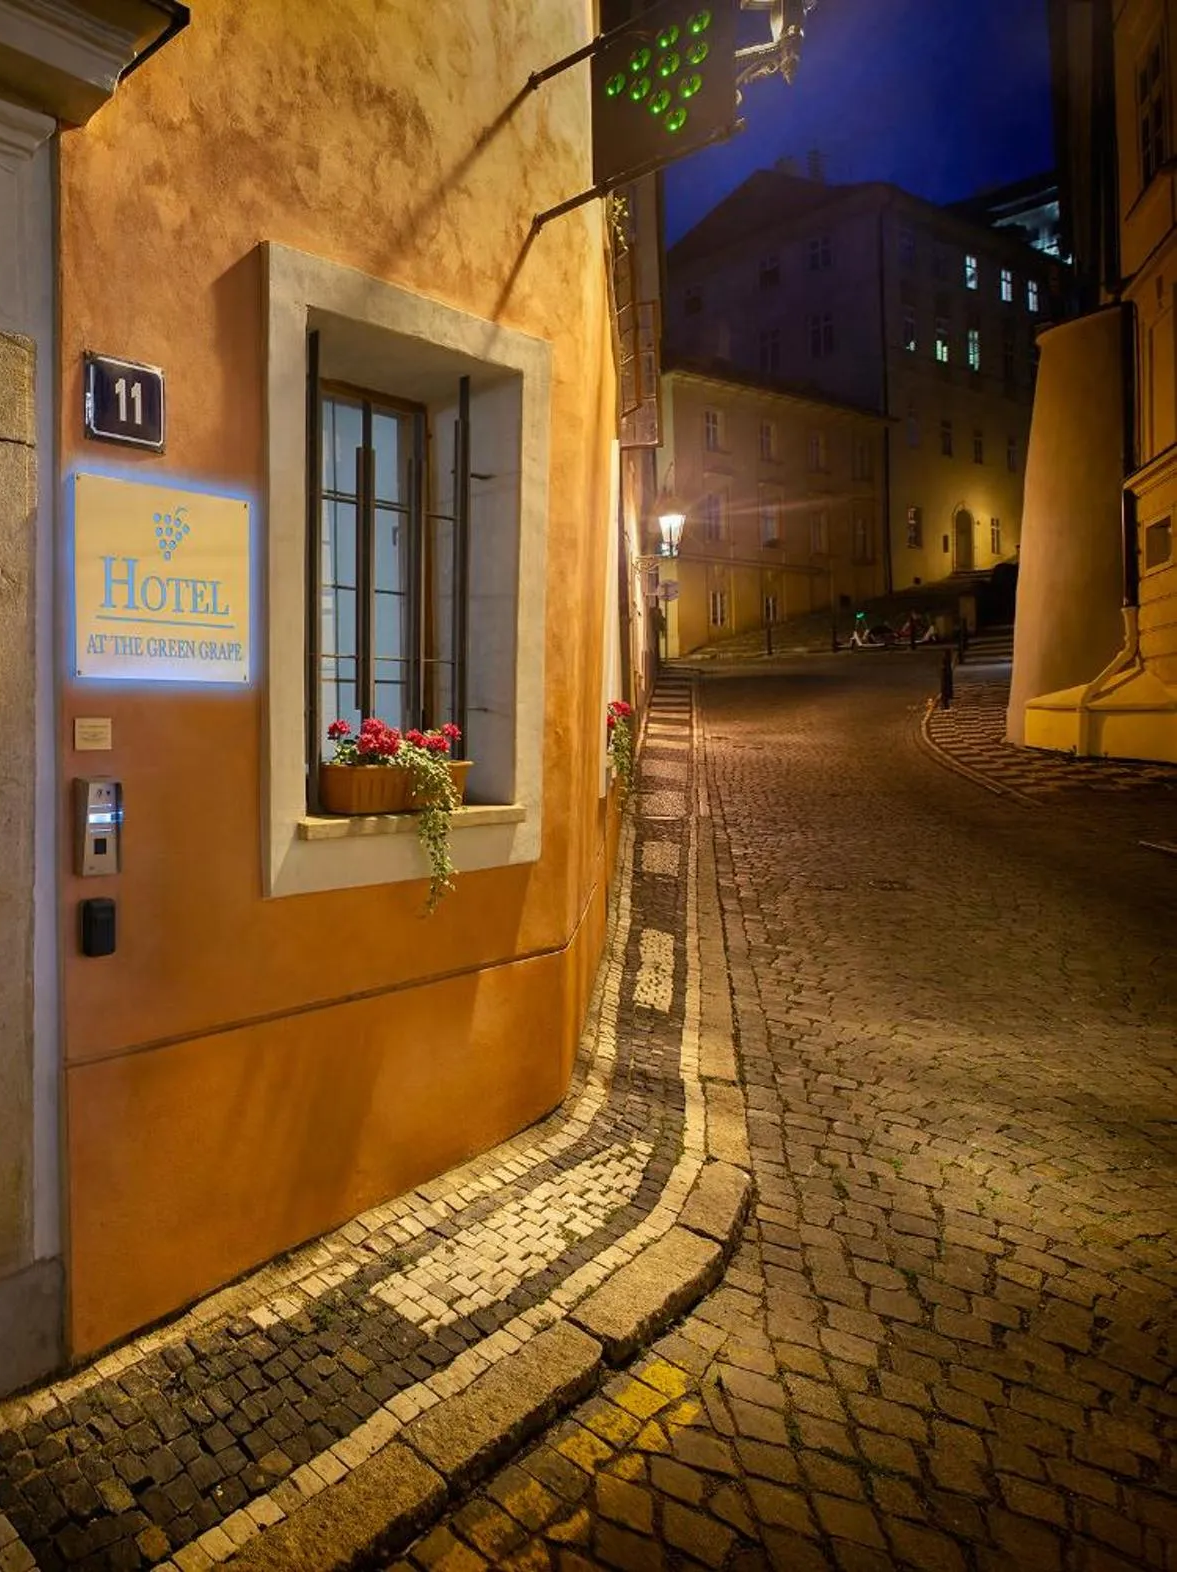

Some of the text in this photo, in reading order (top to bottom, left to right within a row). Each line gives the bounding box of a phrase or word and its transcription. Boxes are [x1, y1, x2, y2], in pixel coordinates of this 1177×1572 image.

[114, 377, 142, 424] 11
[99, 556, 229, 615] HOTEL
[87, 634, 242, 661] AT THE GREEN GRAPE
